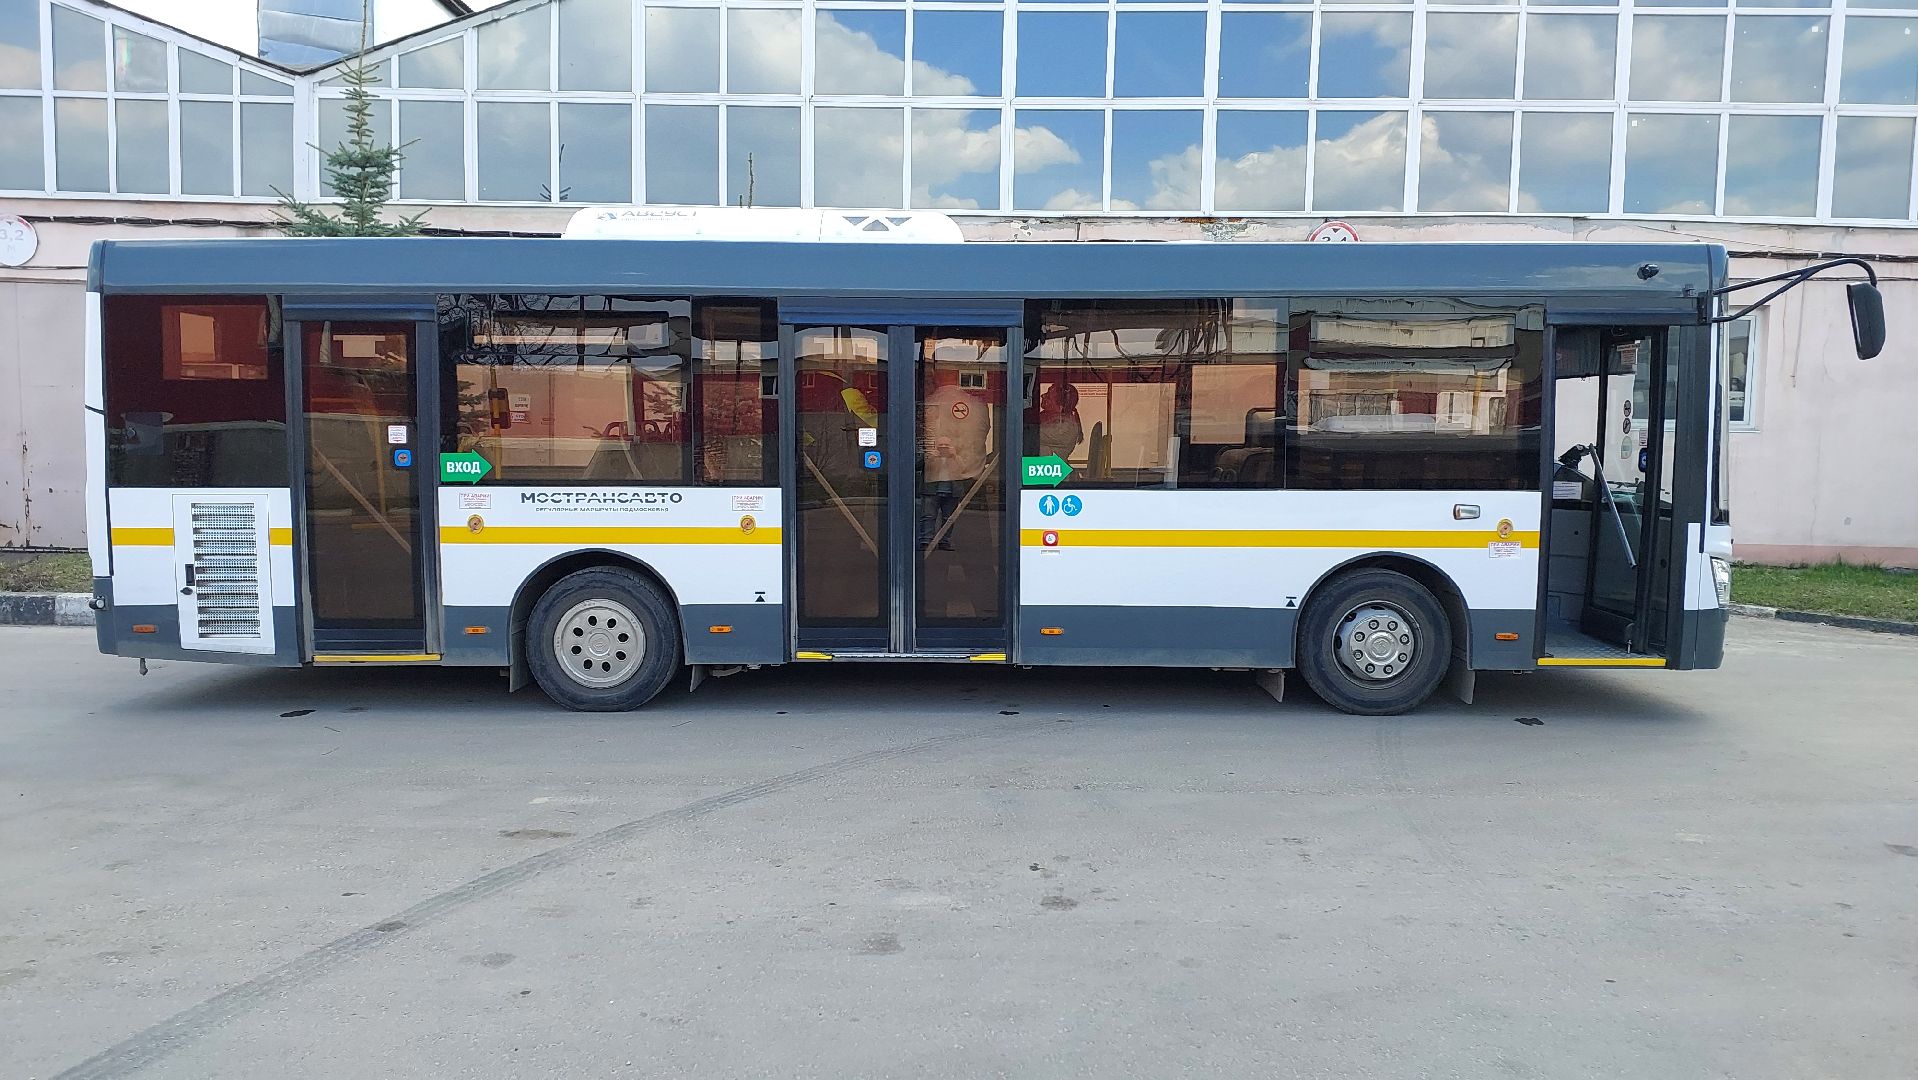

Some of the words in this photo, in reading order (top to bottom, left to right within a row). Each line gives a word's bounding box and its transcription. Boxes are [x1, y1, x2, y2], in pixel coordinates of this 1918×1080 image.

[446, 461, 482, 475] ВХОД
[1028, 464, 1063, 478] ВХОД
[520, 492, 683, 504] МОСТРАНСАВТО
